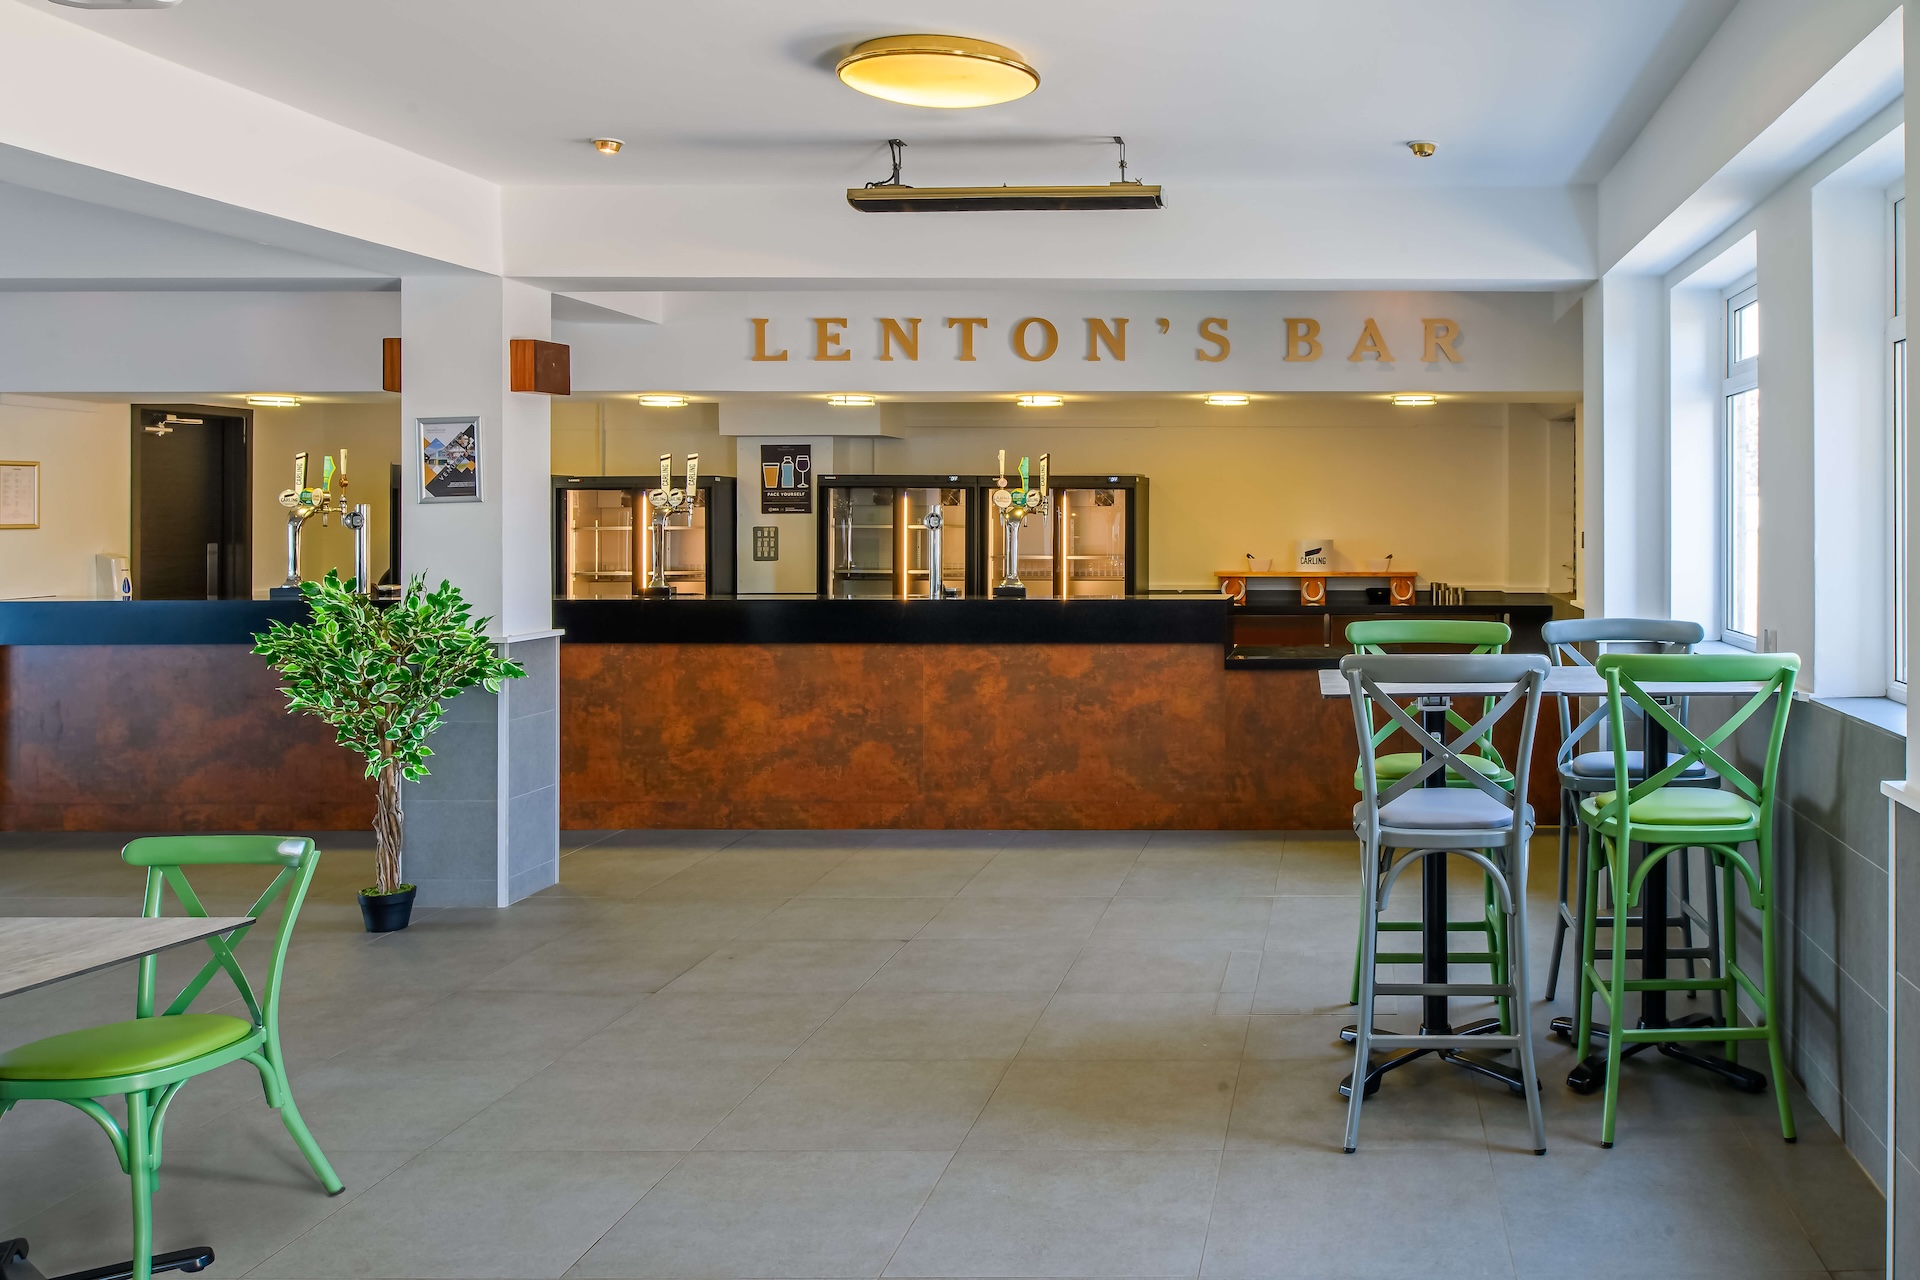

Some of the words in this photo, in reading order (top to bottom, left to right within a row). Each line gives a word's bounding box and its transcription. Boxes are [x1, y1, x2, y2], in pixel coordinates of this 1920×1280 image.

[752, 317, 1231, 363] LENTON'S
[1283, 317, 1464, 363] BAR
[661, 463, 669, 487] CARLING
[688, 463, 697, 487] CARLING
[1300, 556, 1327, 565] CARLING
